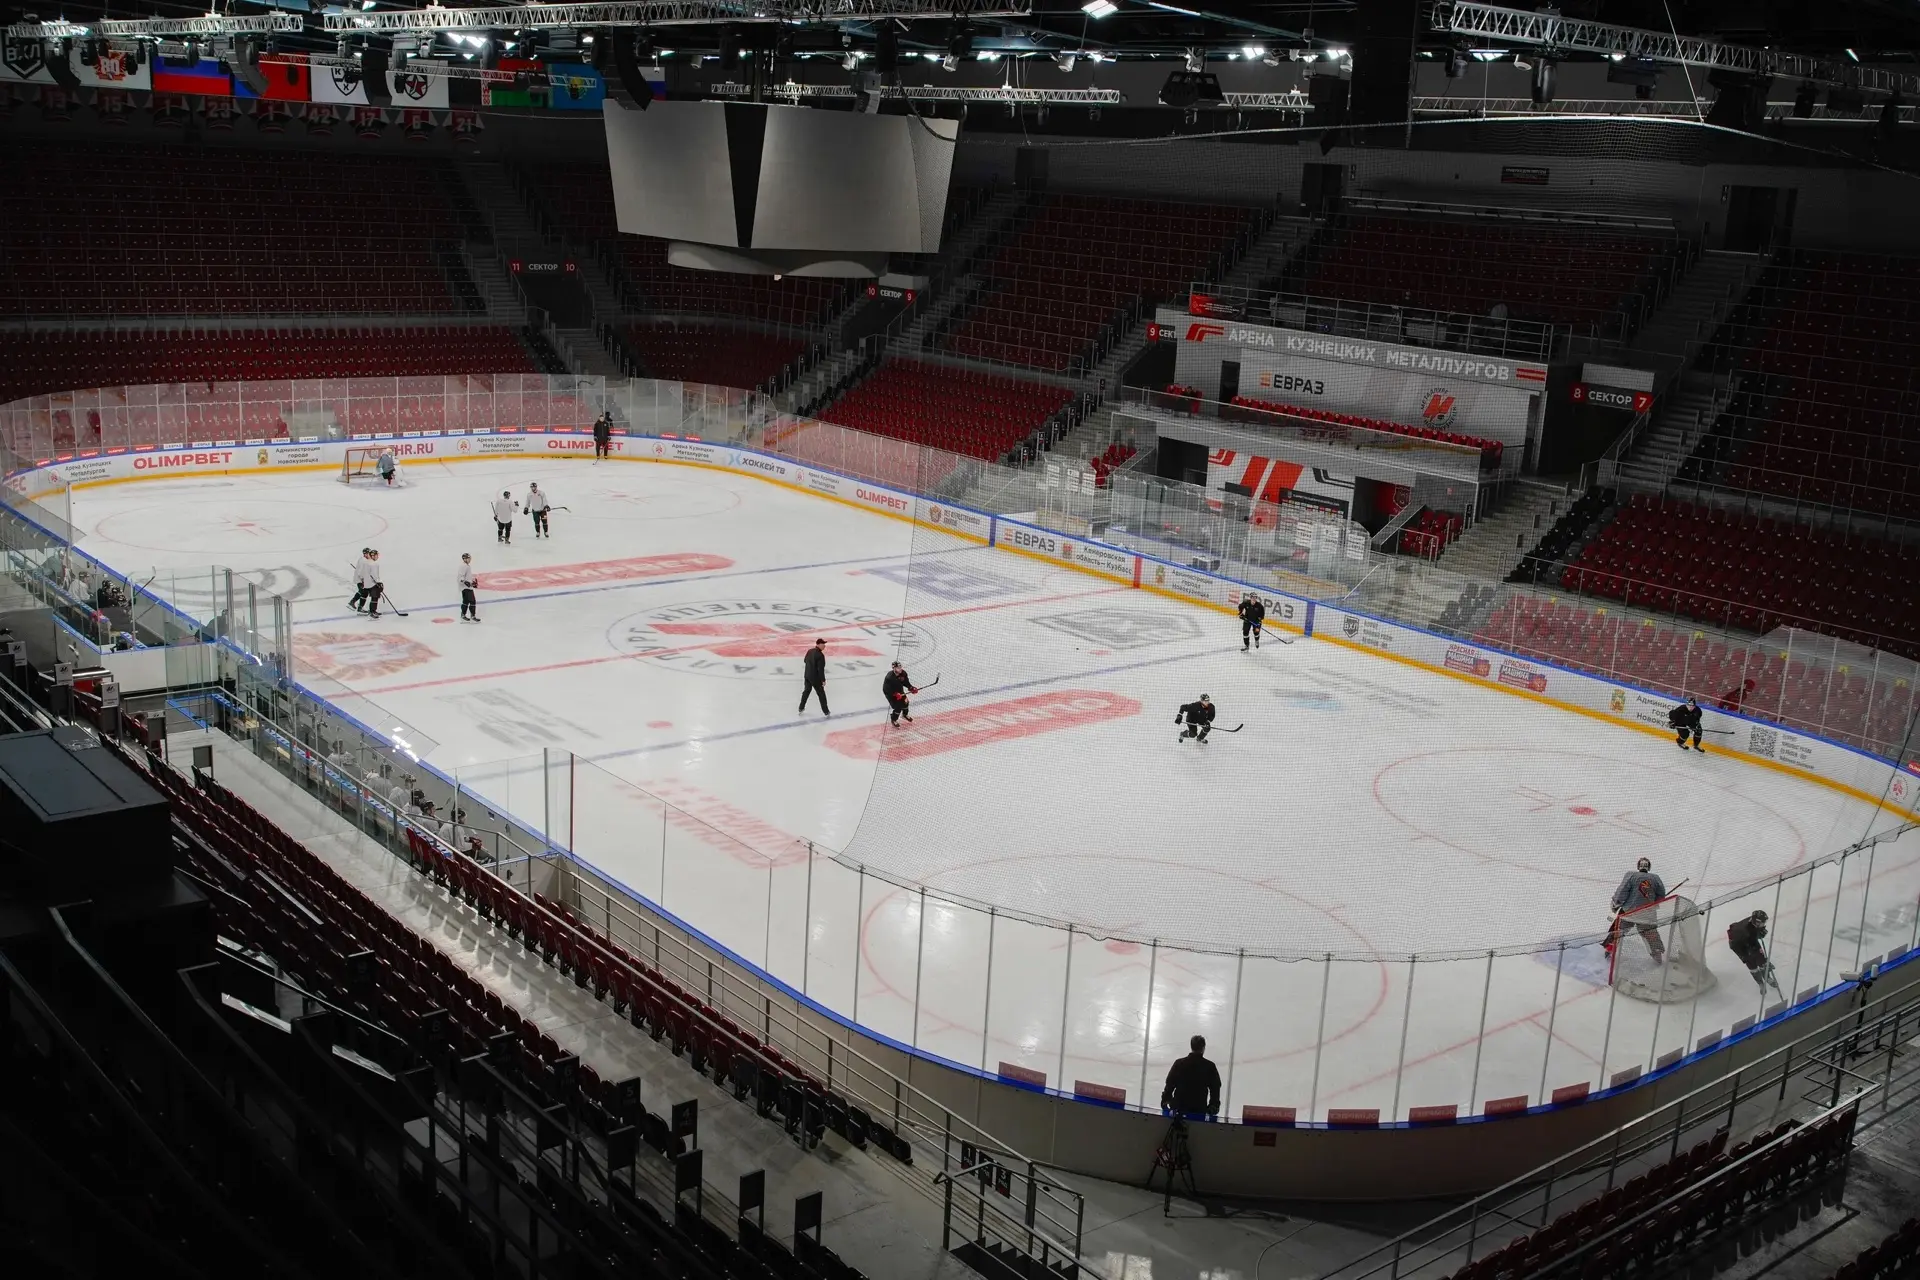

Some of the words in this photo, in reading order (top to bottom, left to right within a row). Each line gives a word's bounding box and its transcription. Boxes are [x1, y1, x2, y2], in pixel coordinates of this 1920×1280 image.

[101, 59, 120, 75] 80
[309, 107, 332, 124] 42
[512, 263, 520, 271] 11
[528, 263, 558, 271] СЕКТОР
[880, 289, 902, 299] СЕКТОР
[1150, 328, 1156, 336] 9
[1159, 329, 1176, 338] СЕКТ
[1228, 328, 1275, 347] АРЕНА
[1287, 336, 1376, 362] КУЗНЕЦКИХ
[1386, 350, 1509, 380] МЕТАЛЛУРГОВ
[1273, 374, 1324, 395] ЕВРАЗ
[1573, 387, 1581, 399] 8
[1588, 390, 1632, 405] СЕКТОР
[1638, 397, 1647, 408] 7
[275, 446, 320, 454] Администрация
[547, 440, 624, 451] OLIMPET
[133, 452, 232, 470] OLIMPBET
[277, 457, 319, 465] Новокузнецка
[742, 458, 774, 474] ХОККЕЙ
[775, 466, 786, 475] ТВ
[856, 488, 908, 511] OLIMPBET
[1015, 531, 1055, 553] ЕВРАЗ
[1084, 545, 1126, 563] Кемеровская
[484, 556, 707, 586] OLIMPBET
[1106, 561, 1133, 576] Кузбасс
[1636, 695, 1676, 711] Админист
